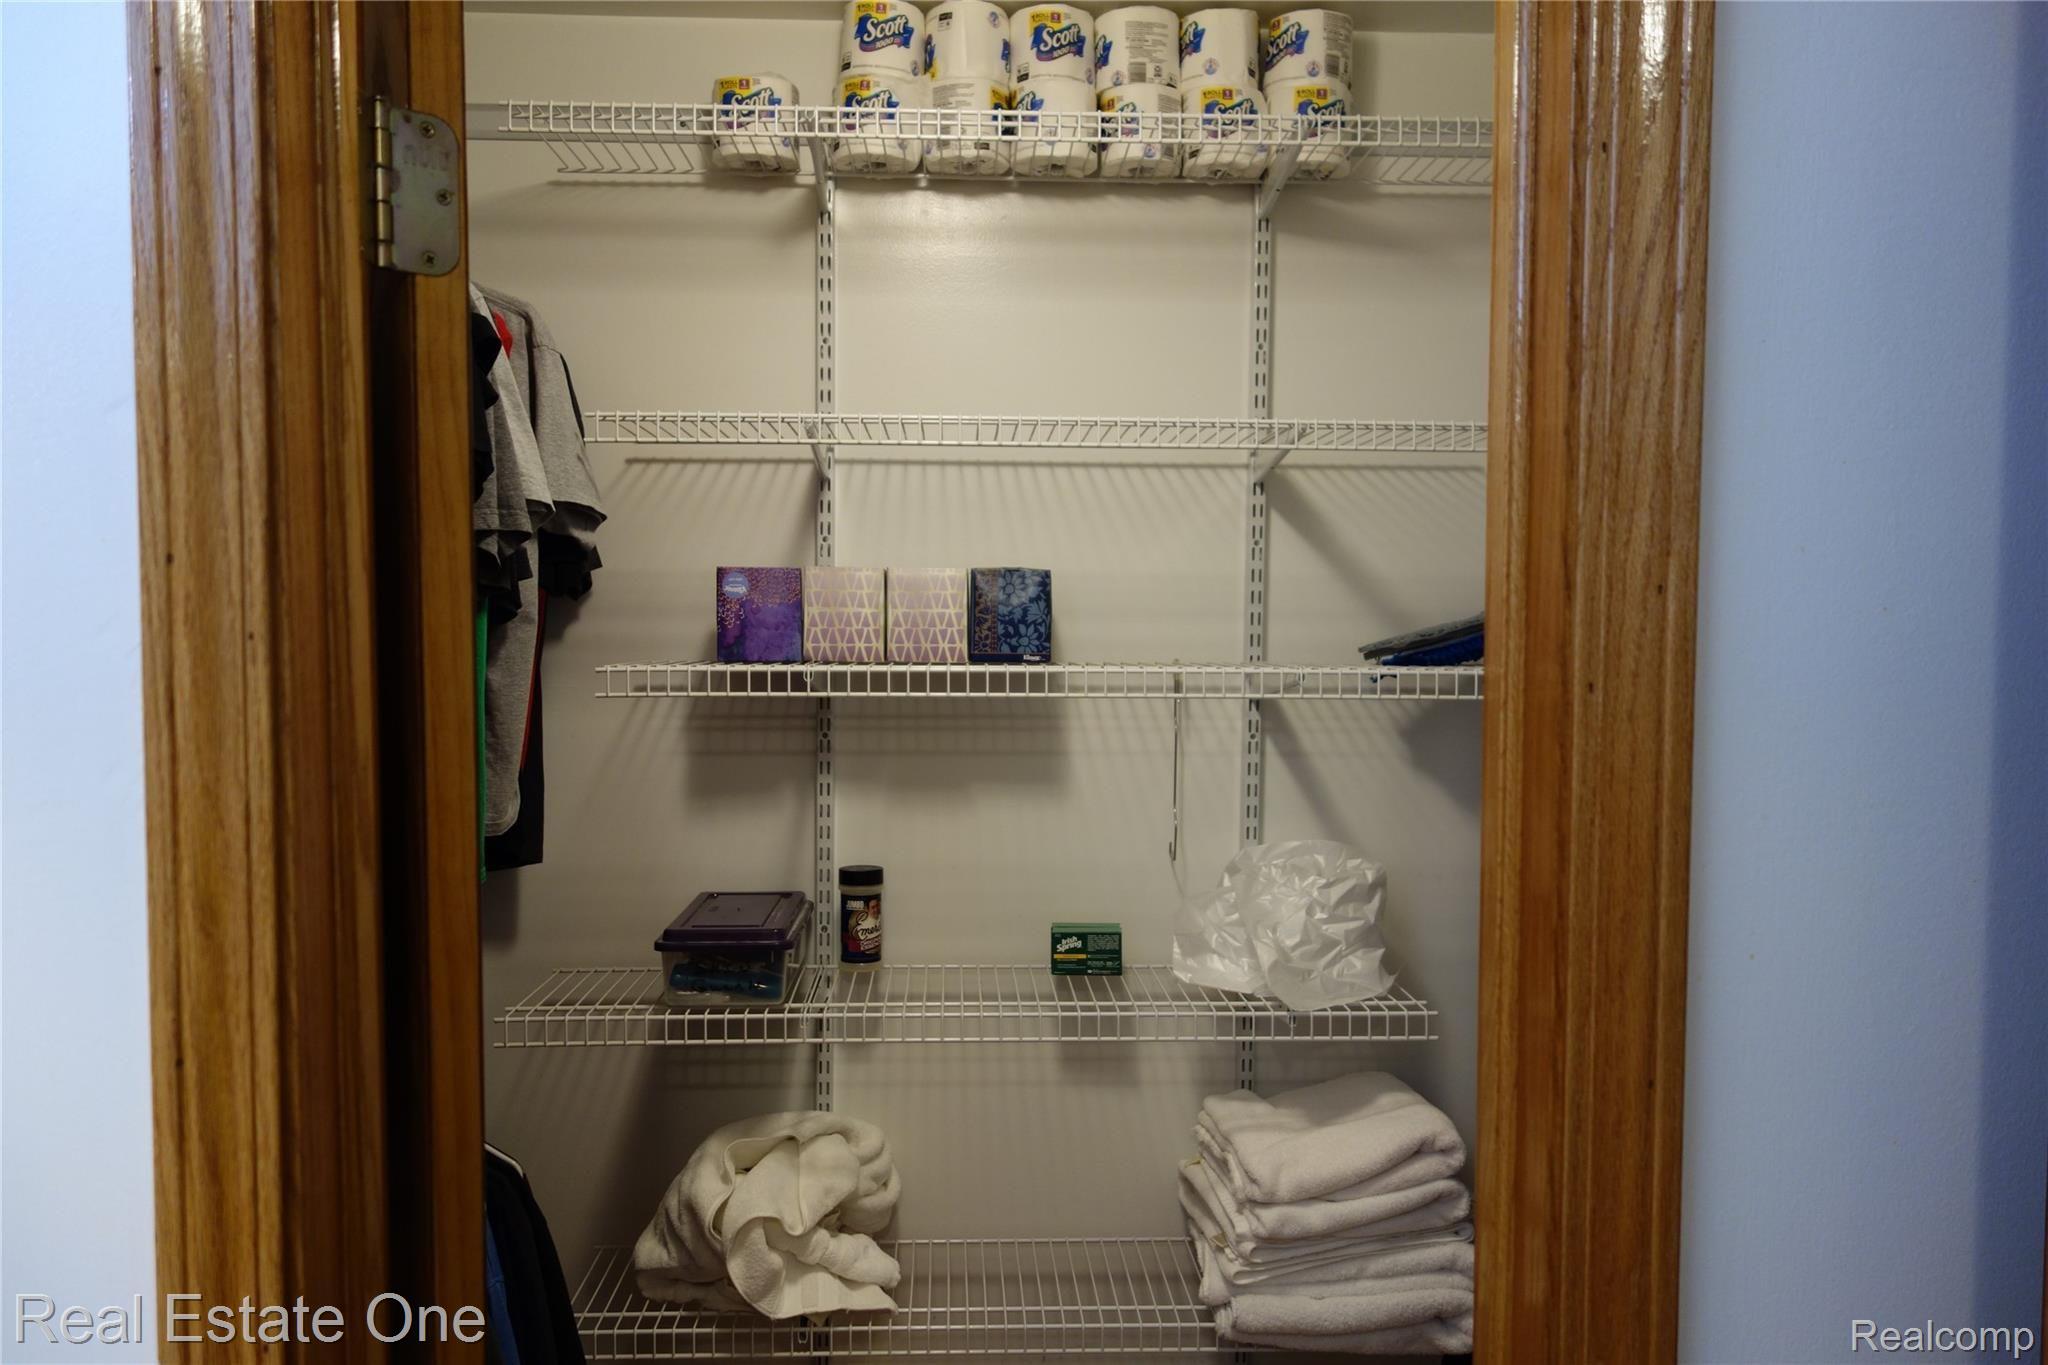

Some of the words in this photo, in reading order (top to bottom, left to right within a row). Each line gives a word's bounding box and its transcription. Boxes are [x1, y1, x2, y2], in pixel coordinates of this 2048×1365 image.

[862, 16, 907, 42] Scott
[1039, 24, 1080, 52] Scott
[730, 87, 773, 119] Scott
[848, 89, 890, 118] Scott
[1056, 940, 1083, 953] Spring
[1061, 935, 1078, 945] Irish
